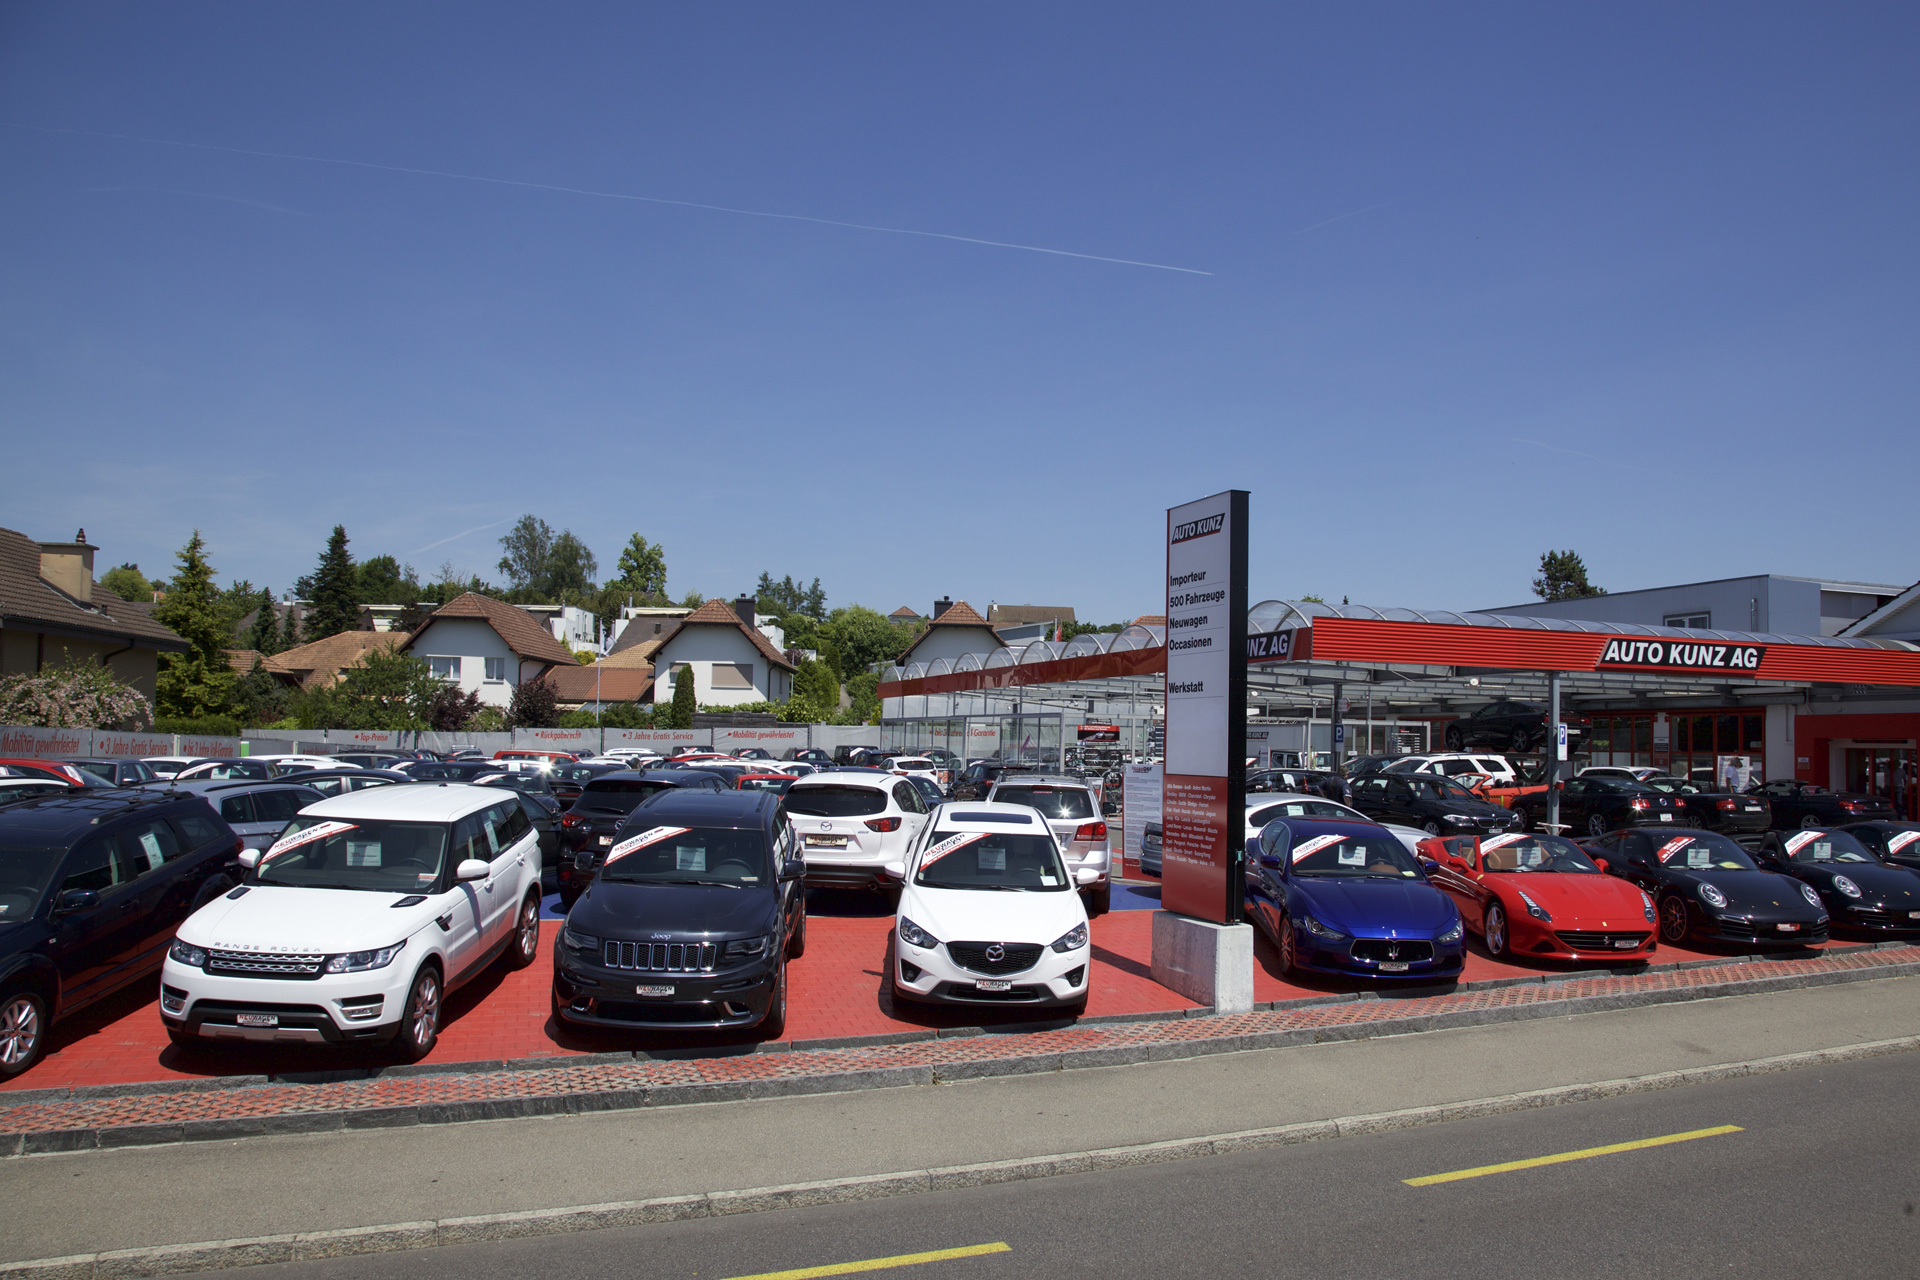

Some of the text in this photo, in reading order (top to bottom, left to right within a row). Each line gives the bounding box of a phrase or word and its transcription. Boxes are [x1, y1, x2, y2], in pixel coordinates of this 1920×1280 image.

[1173, 515, 1222, 540] AUTO KUNZ
[1170, 571, 1206, 587] Importeur
[1170, 590, 1225, 608] 500 Fahrzeuge
[1170, 616, 1208, 629] Neuwagen
[1169, 637, 1212, 650] Occasionen
[1247, 634, 1288, 658] NZ AG
[1604, 640, 1758, 668] AUTO KUNZ AG
[1168, 681, 1204, 694] Werkstatt
[360, 733, 388, 742] Top-Preise
[540, 731, 582, 740] Rückgaberecht
[634, 732, 650, 740] Jahre
[653, 732, 670, 740] Gratis
[758, 731, 794, 740] gewährleistet
[1, 731, 80, 758] Mobilität gewährleistet
[105, 737, 168, 756] 3 Jahre Gratis Service
[274, 828, 318, 848] NEUWAGEN
[614, 832, 653, 851] NEUWAGEN
[925, 834, 965, 856] NEUWAGEN
[214, 942, 260, 950] RANGE
[239, 1015, 276, 1024] NEUWAGEN
